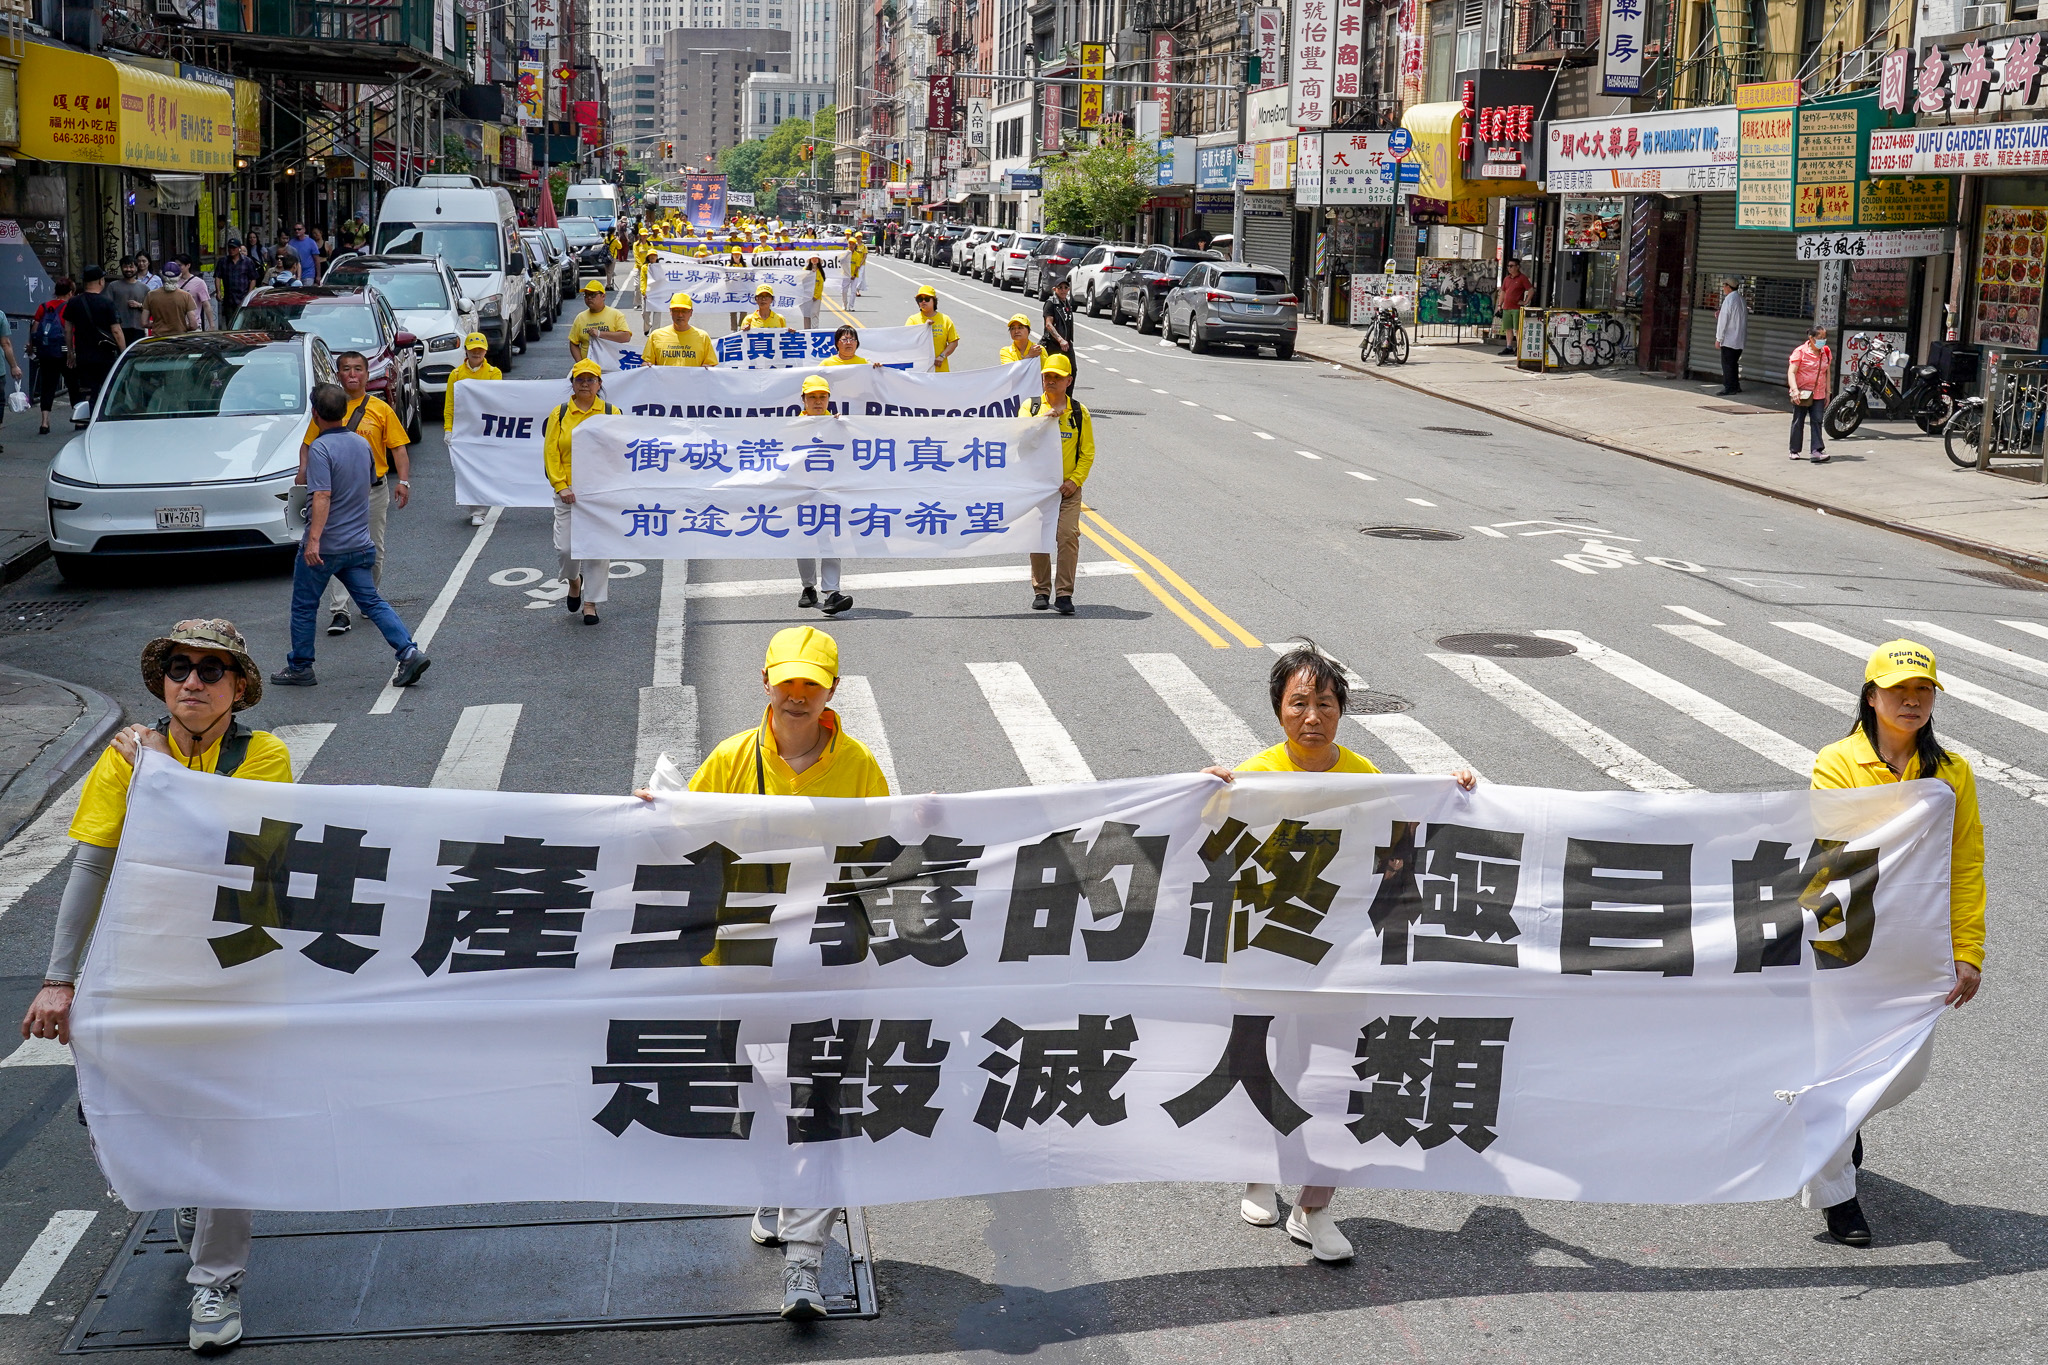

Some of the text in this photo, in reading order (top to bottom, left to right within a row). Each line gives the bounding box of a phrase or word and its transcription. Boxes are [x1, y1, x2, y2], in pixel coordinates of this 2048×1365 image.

[49, 116, 117, 132] 福州小吃店
[1654, 128, 1701, 152] PHARMACY
[1703, 126, 1719, 150] INC
[1872, 134, 1915, 150] 212-274-8659
[1915, 125, 2048, 153] JUFU GARDEN RESTAUR
[1870, 154, 1914, 170] 212-925-1637
[1864, 181, 1945, 196] 金龍快車
[752, 255, 805, 267] Ultimate
[662, 350, 696, 359] FALUN DAFA
[481, 413, 534, 439] THE
[624, 436, 1008, 473] 衝破謊言明真相
[180, 511, 200, 523] 2673
[623, 501, 1010, 539] 前途光明有希望
[1888, 651, 1913, 659] Falun
[207, 815, 1882, 978] 共產主義的終極目的
[591, 1012, 1514, 1154] 是毀滅人類
